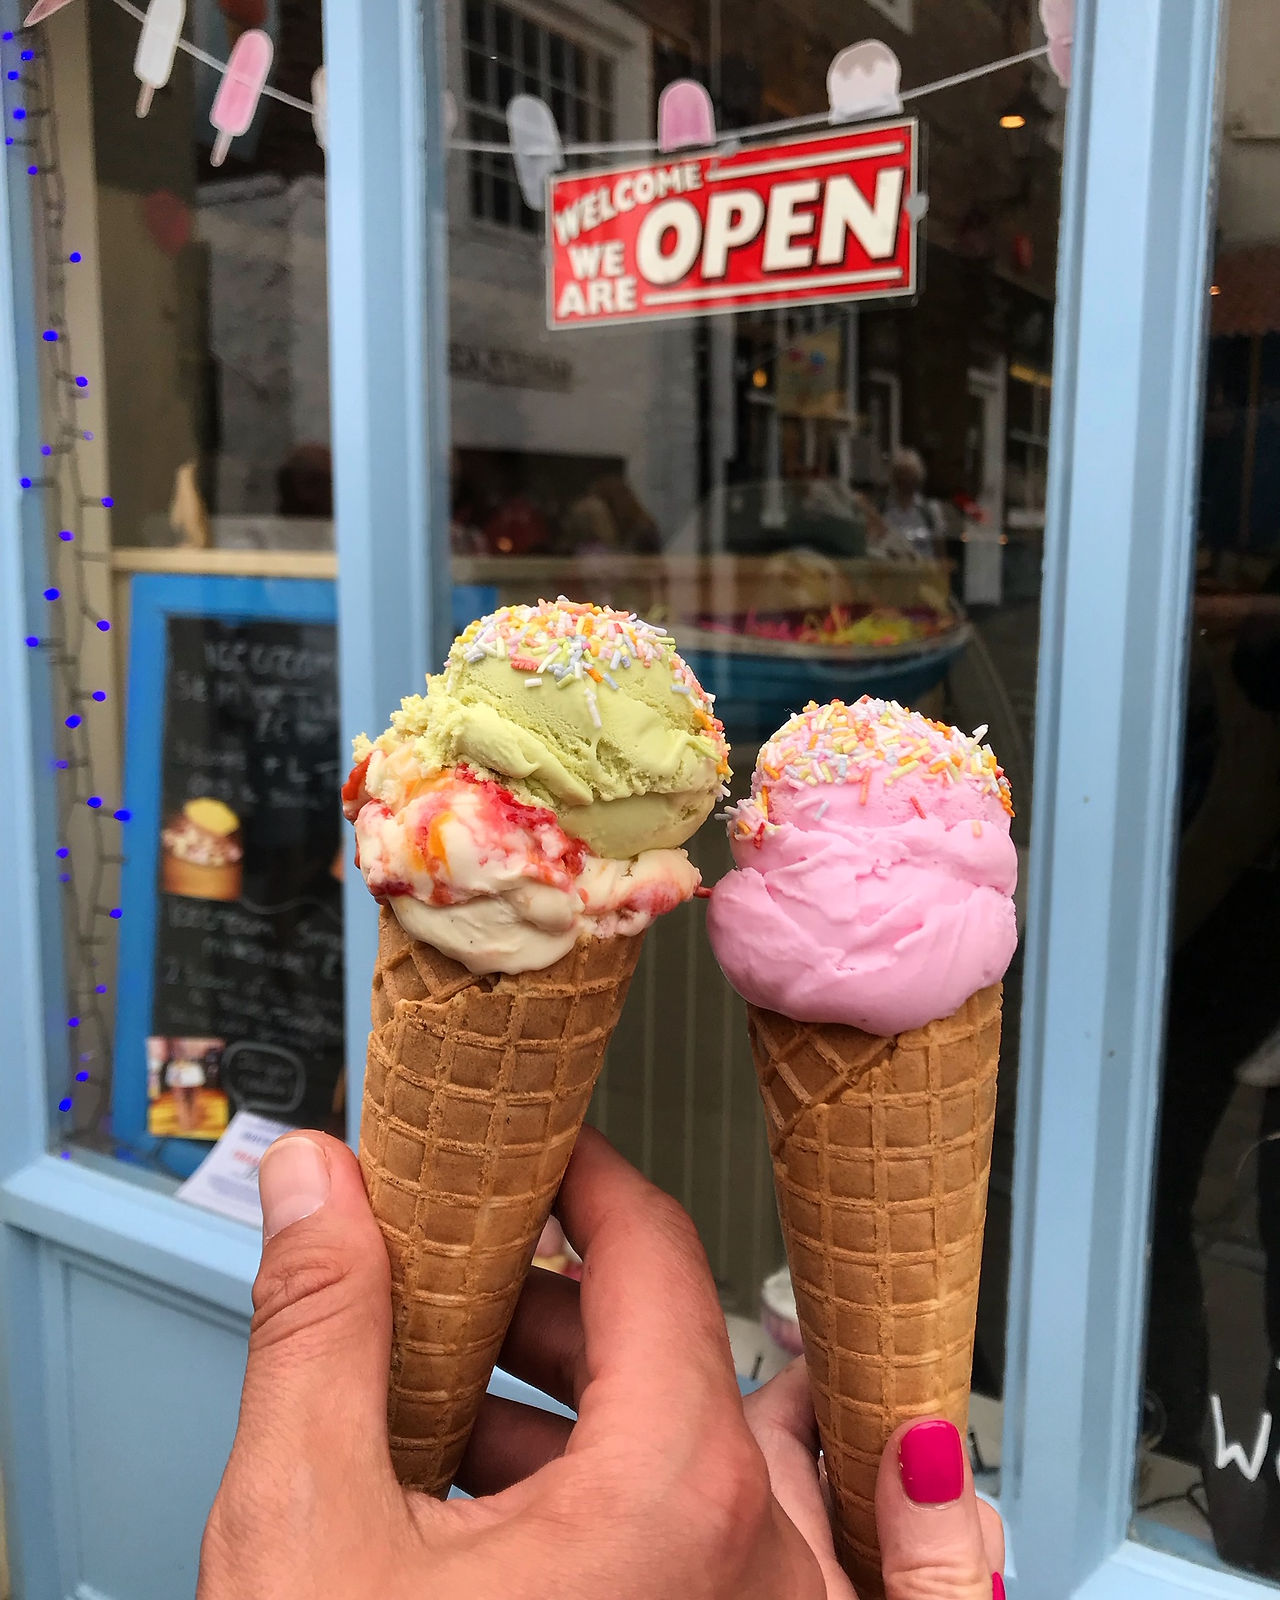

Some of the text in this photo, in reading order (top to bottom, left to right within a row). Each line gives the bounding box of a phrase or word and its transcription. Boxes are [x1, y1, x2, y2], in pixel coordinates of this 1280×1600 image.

[554, 163, 703, 246] WELCOME
[635, 166, 905, 286] OPEN
[556, 276, 638, 319] ARE
[567, 239, 625, 281] WE
[1209, 1391, 1280, 1483] W
